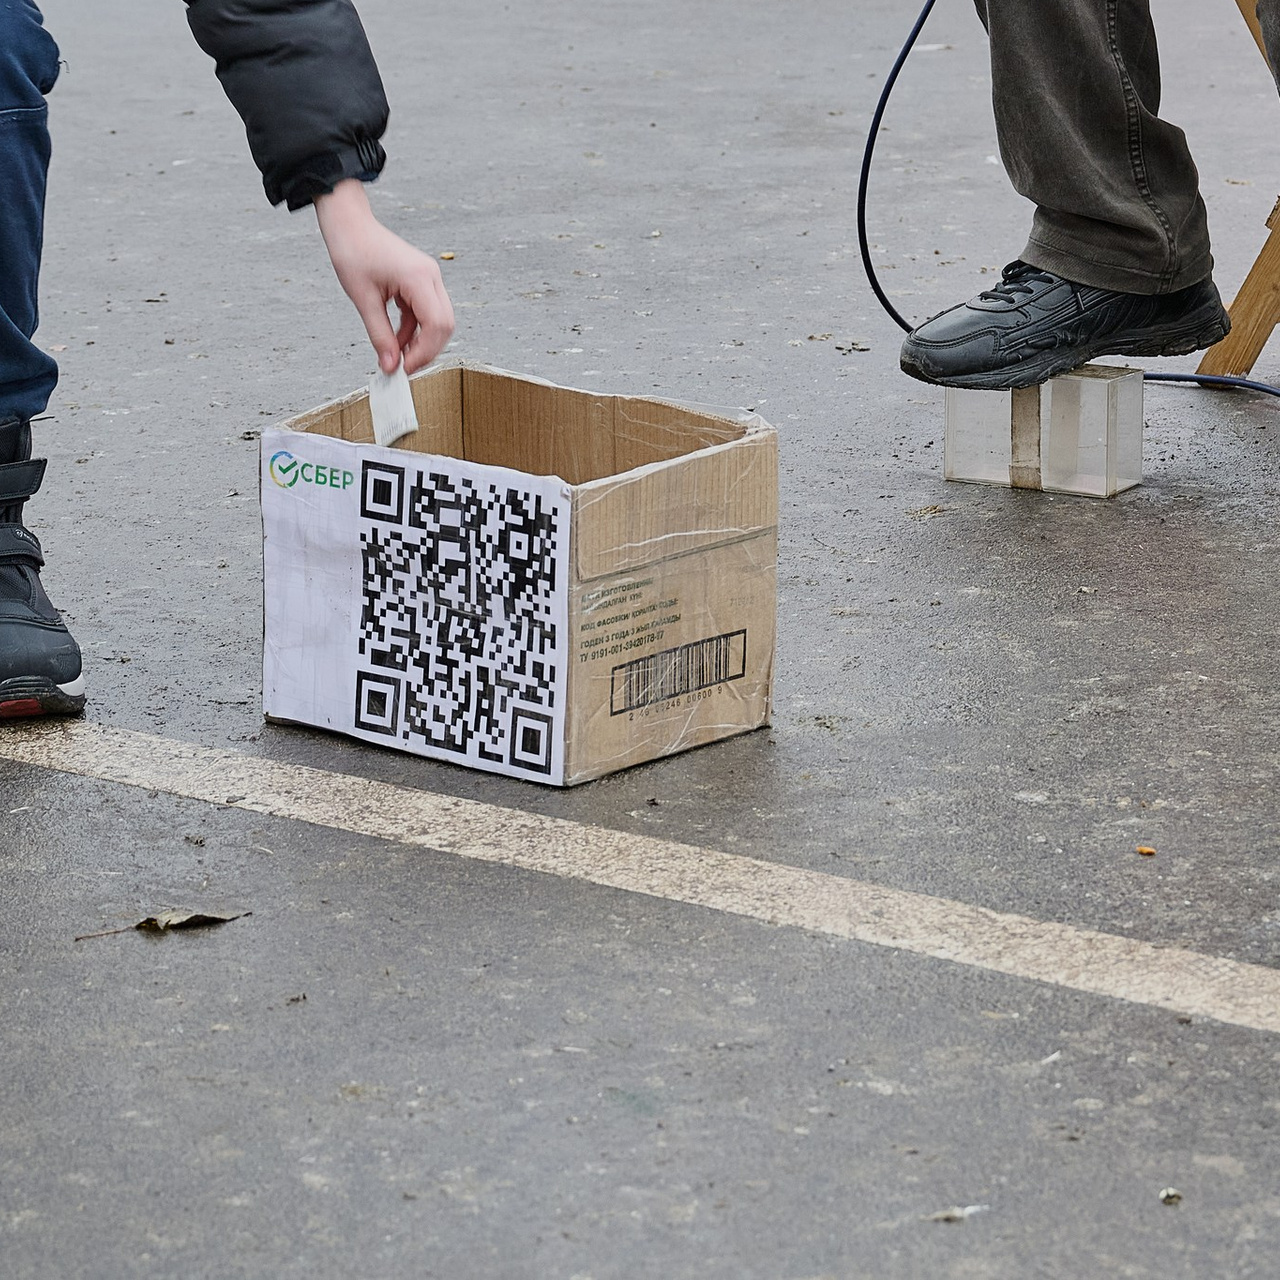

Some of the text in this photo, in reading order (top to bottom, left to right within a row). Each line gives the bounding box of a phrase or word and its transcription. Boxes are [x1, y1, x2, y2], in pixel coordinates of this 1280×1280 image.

[301, 462, 354, 490] СБЕР
[580, 636, 604, 650] ГОДЕН
[611, 630, 630, 642] ГОДА
[579, 652, 590, 664] ТУ
[628, 712, 634, 721] 2
[686, 688, 713, 705] 00600
[717, 685, 723, 694] 9
